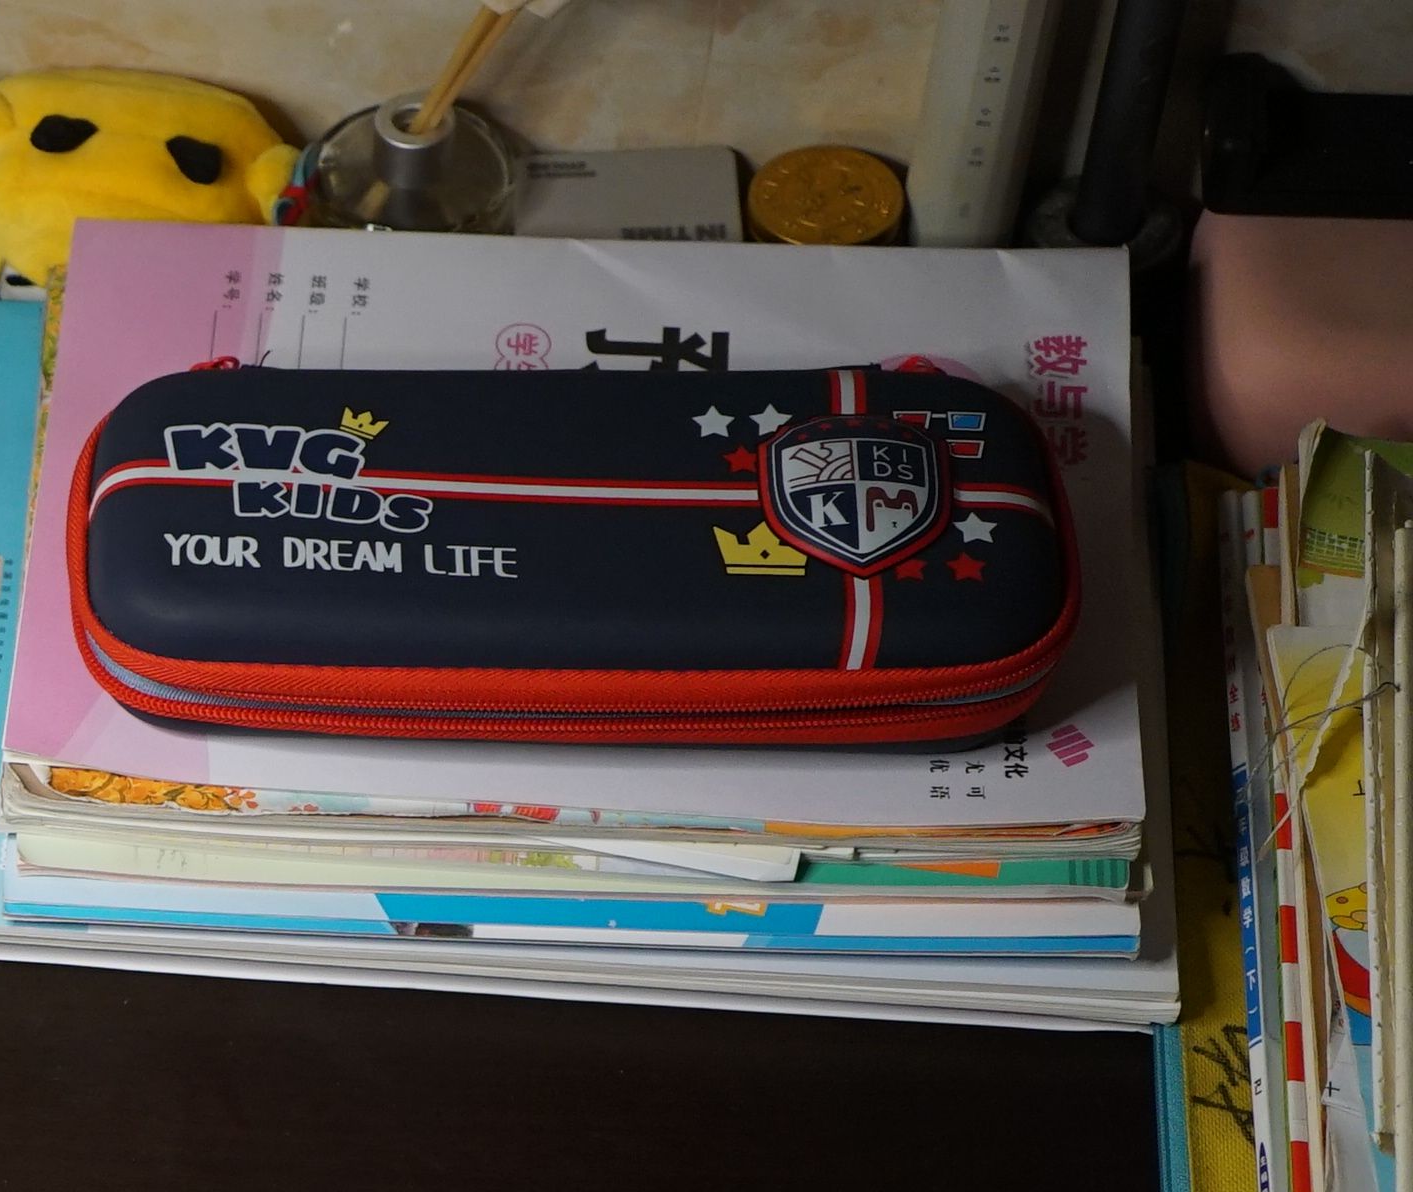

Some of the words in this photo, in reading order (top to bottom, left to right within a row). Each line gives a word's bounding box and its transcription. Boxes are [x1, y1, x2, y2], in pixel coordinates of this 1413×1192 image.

[231, 477, 434, 534] KIDS
[806, 491, 852, 530] K
[163, 532, 262, 570] YOUR
[282, 537, 403, 575] DREAM
[423, 543, 519, 580] LIFE
